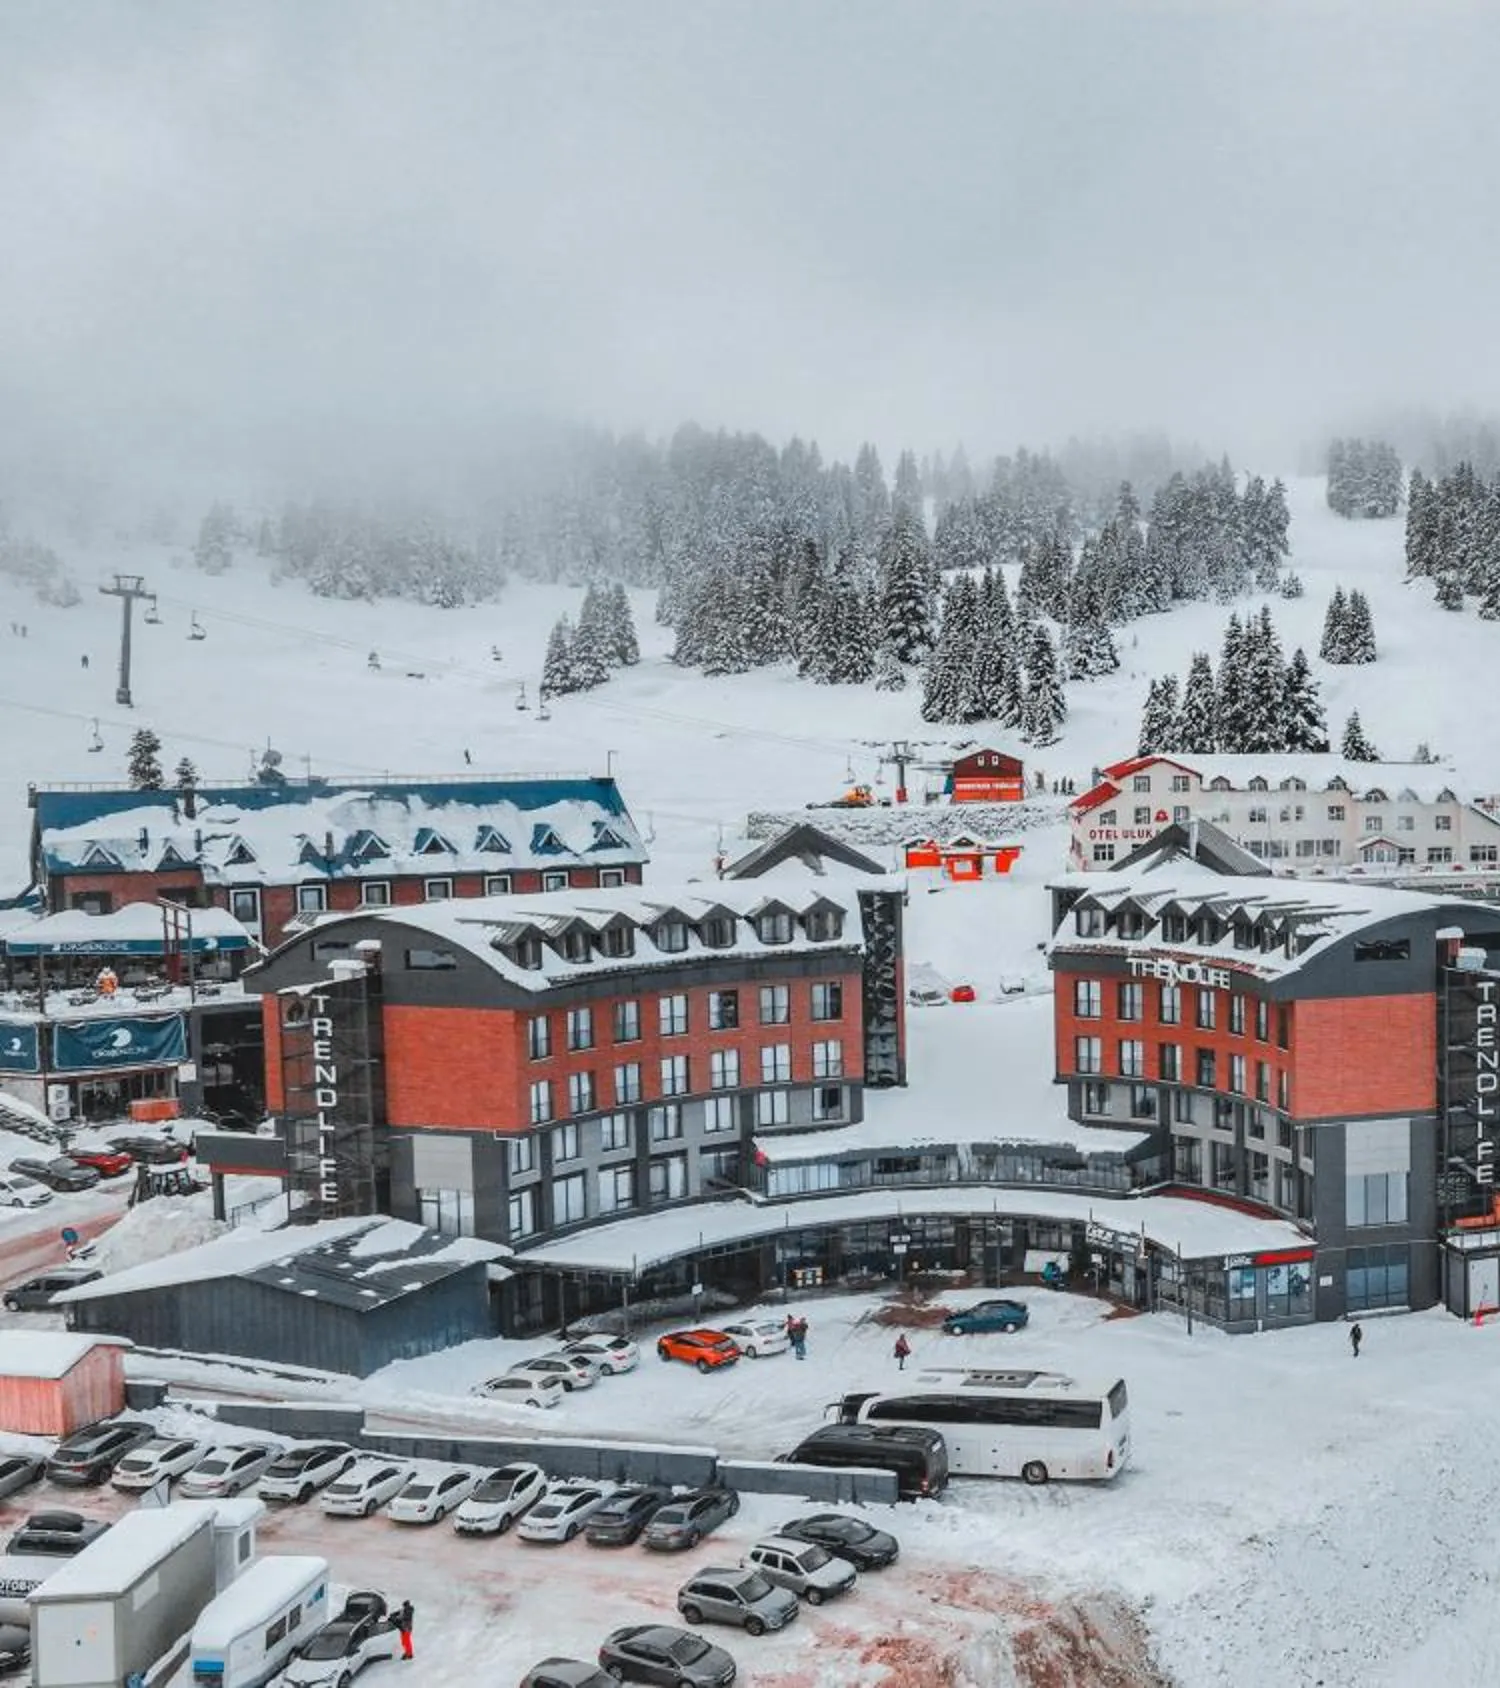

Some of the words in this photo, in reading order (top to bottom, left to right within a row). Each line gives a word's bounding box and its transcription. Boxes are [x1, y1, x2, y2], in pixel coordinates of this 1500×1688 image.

[1089, 829, 1118, 840] OTEL
[1126, 958, 1231, 990] TRENDLIFE
[311, 995, 339, 1202] TRENDLIFE
[1476, 981, 1499, 1184] TRENDLIFE
